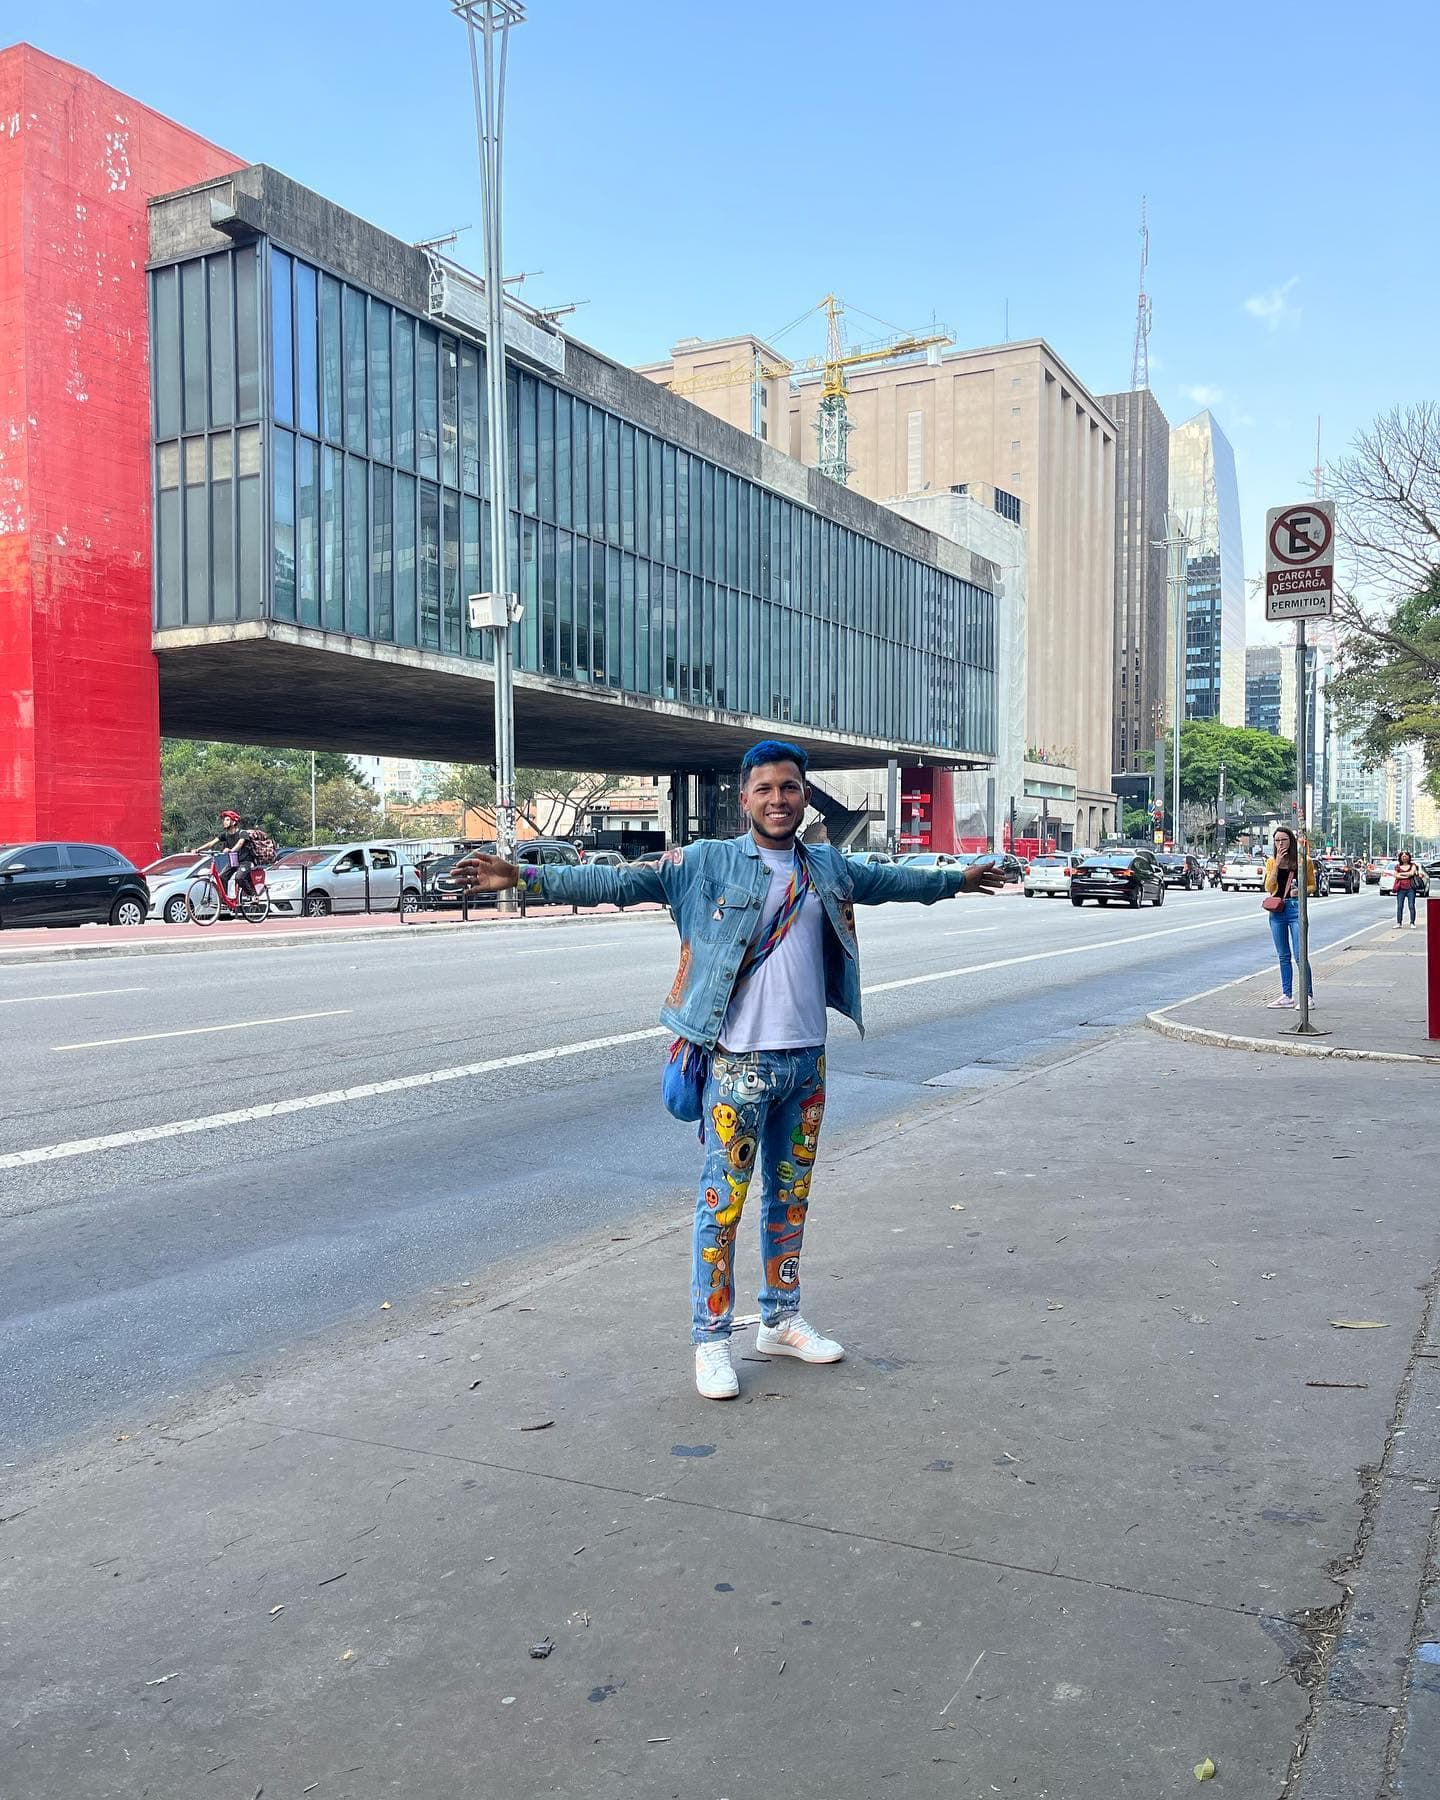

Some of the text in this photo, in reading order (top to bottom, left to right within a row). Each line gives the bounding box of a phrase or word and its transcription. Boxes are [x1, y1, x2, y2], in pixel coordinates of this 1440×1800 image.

[1289, 517, 1311, 554] E
[1278, 569, 1321, 581] CARGA E
[1272, 578, 1326, 592] DESCARGA
[1271, 598, 1326, 610] PERMITIDA
